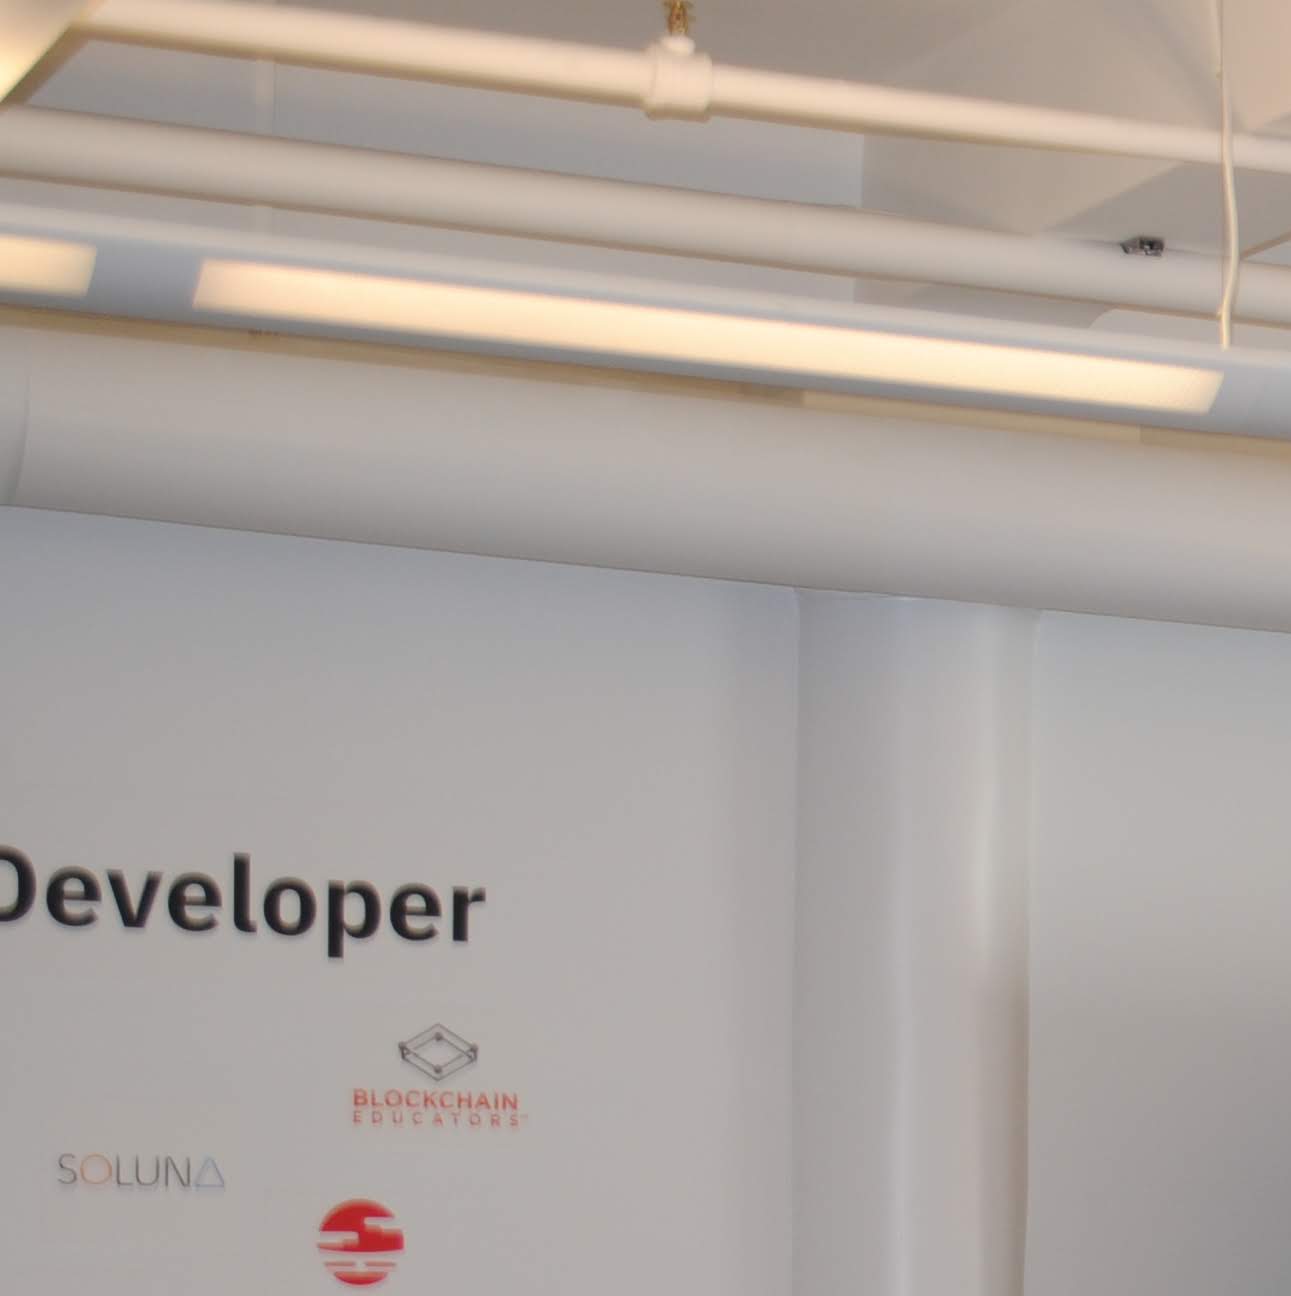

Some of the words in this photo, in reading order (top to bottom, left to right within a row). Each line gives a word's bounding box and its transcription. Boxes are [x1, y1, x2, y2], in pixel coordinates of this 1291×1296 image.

[0, 844, 487, 959] Developer
[353, 1089, 519, 1111] BLOCKCHAIN
[353, 1110, 520, 1127] EDUCATORS
